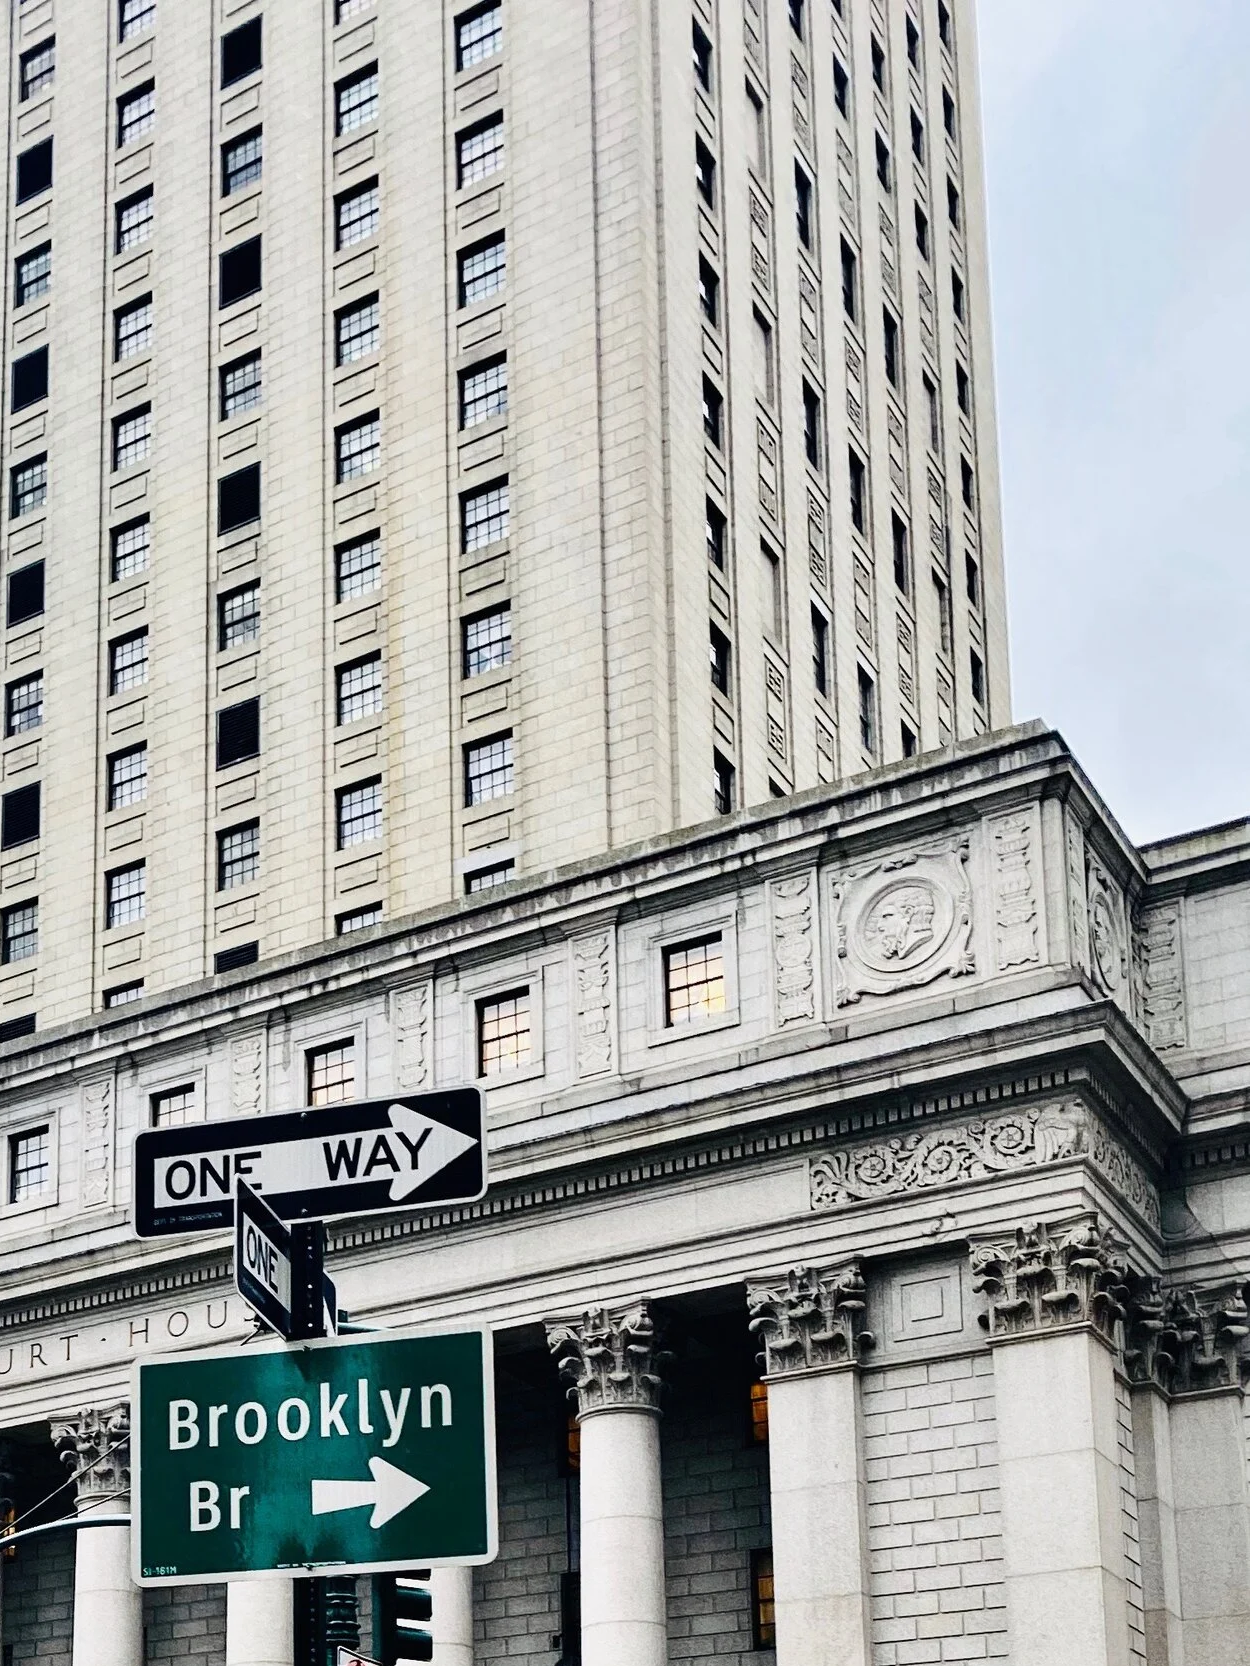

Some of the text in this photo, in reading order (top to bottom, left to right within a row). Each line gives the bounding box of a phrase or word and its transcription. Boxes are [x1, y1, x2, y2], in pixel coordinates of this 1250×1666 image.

[164, 1126, 433, 1201] ONE WAY
[246, 1224, 279, 1295] ONE
[128, 1300, 254, 1347] HOU
[168, 1377, 453, 1451] Brooklyn
[189, 1480, 250, 1532] Br
